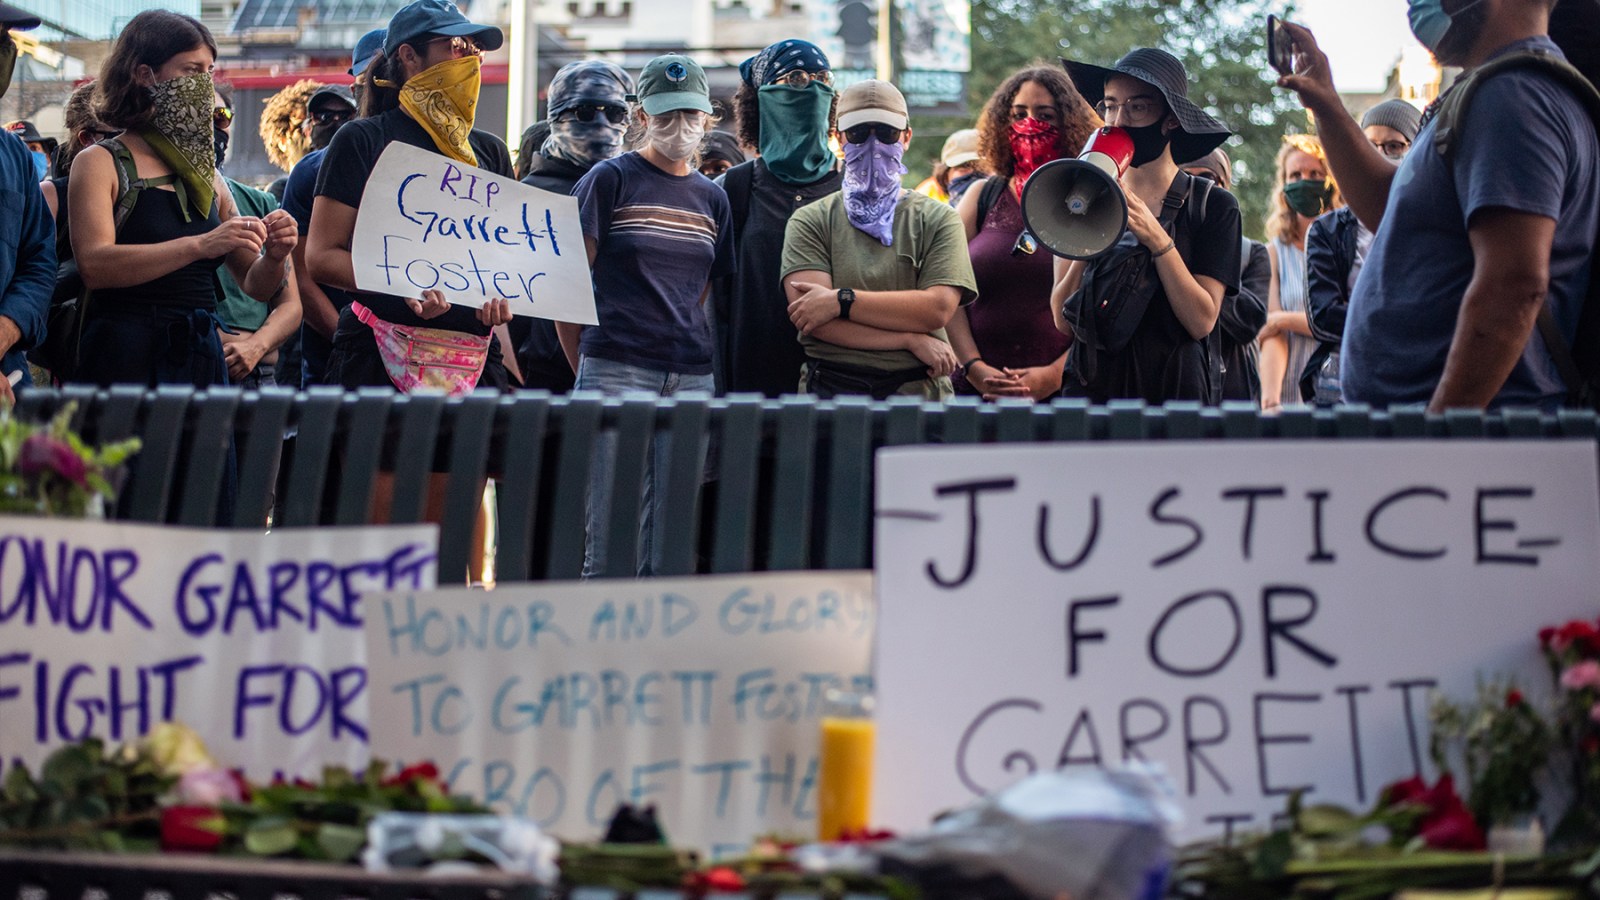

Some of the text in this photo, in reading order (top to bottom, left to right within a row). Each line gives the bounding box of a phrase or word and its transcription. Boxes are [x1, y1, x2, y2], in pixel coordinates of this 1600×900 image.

[397, 173, 561, 256] Garrett
[440, 162, 499, 207] RIP
[376, 235, 546, 303] Foster
[175, 543, 436, 636] GARRETT
[382, 593, 575, 656] HONOR
[588, 592, 699, 641] AND
[1066, 584, 1338, 679] FOR
[233, 664, 370, 745] FOR
[392, 672, 471, 736] TO
[491, 668, 718, 735] GARRETT
